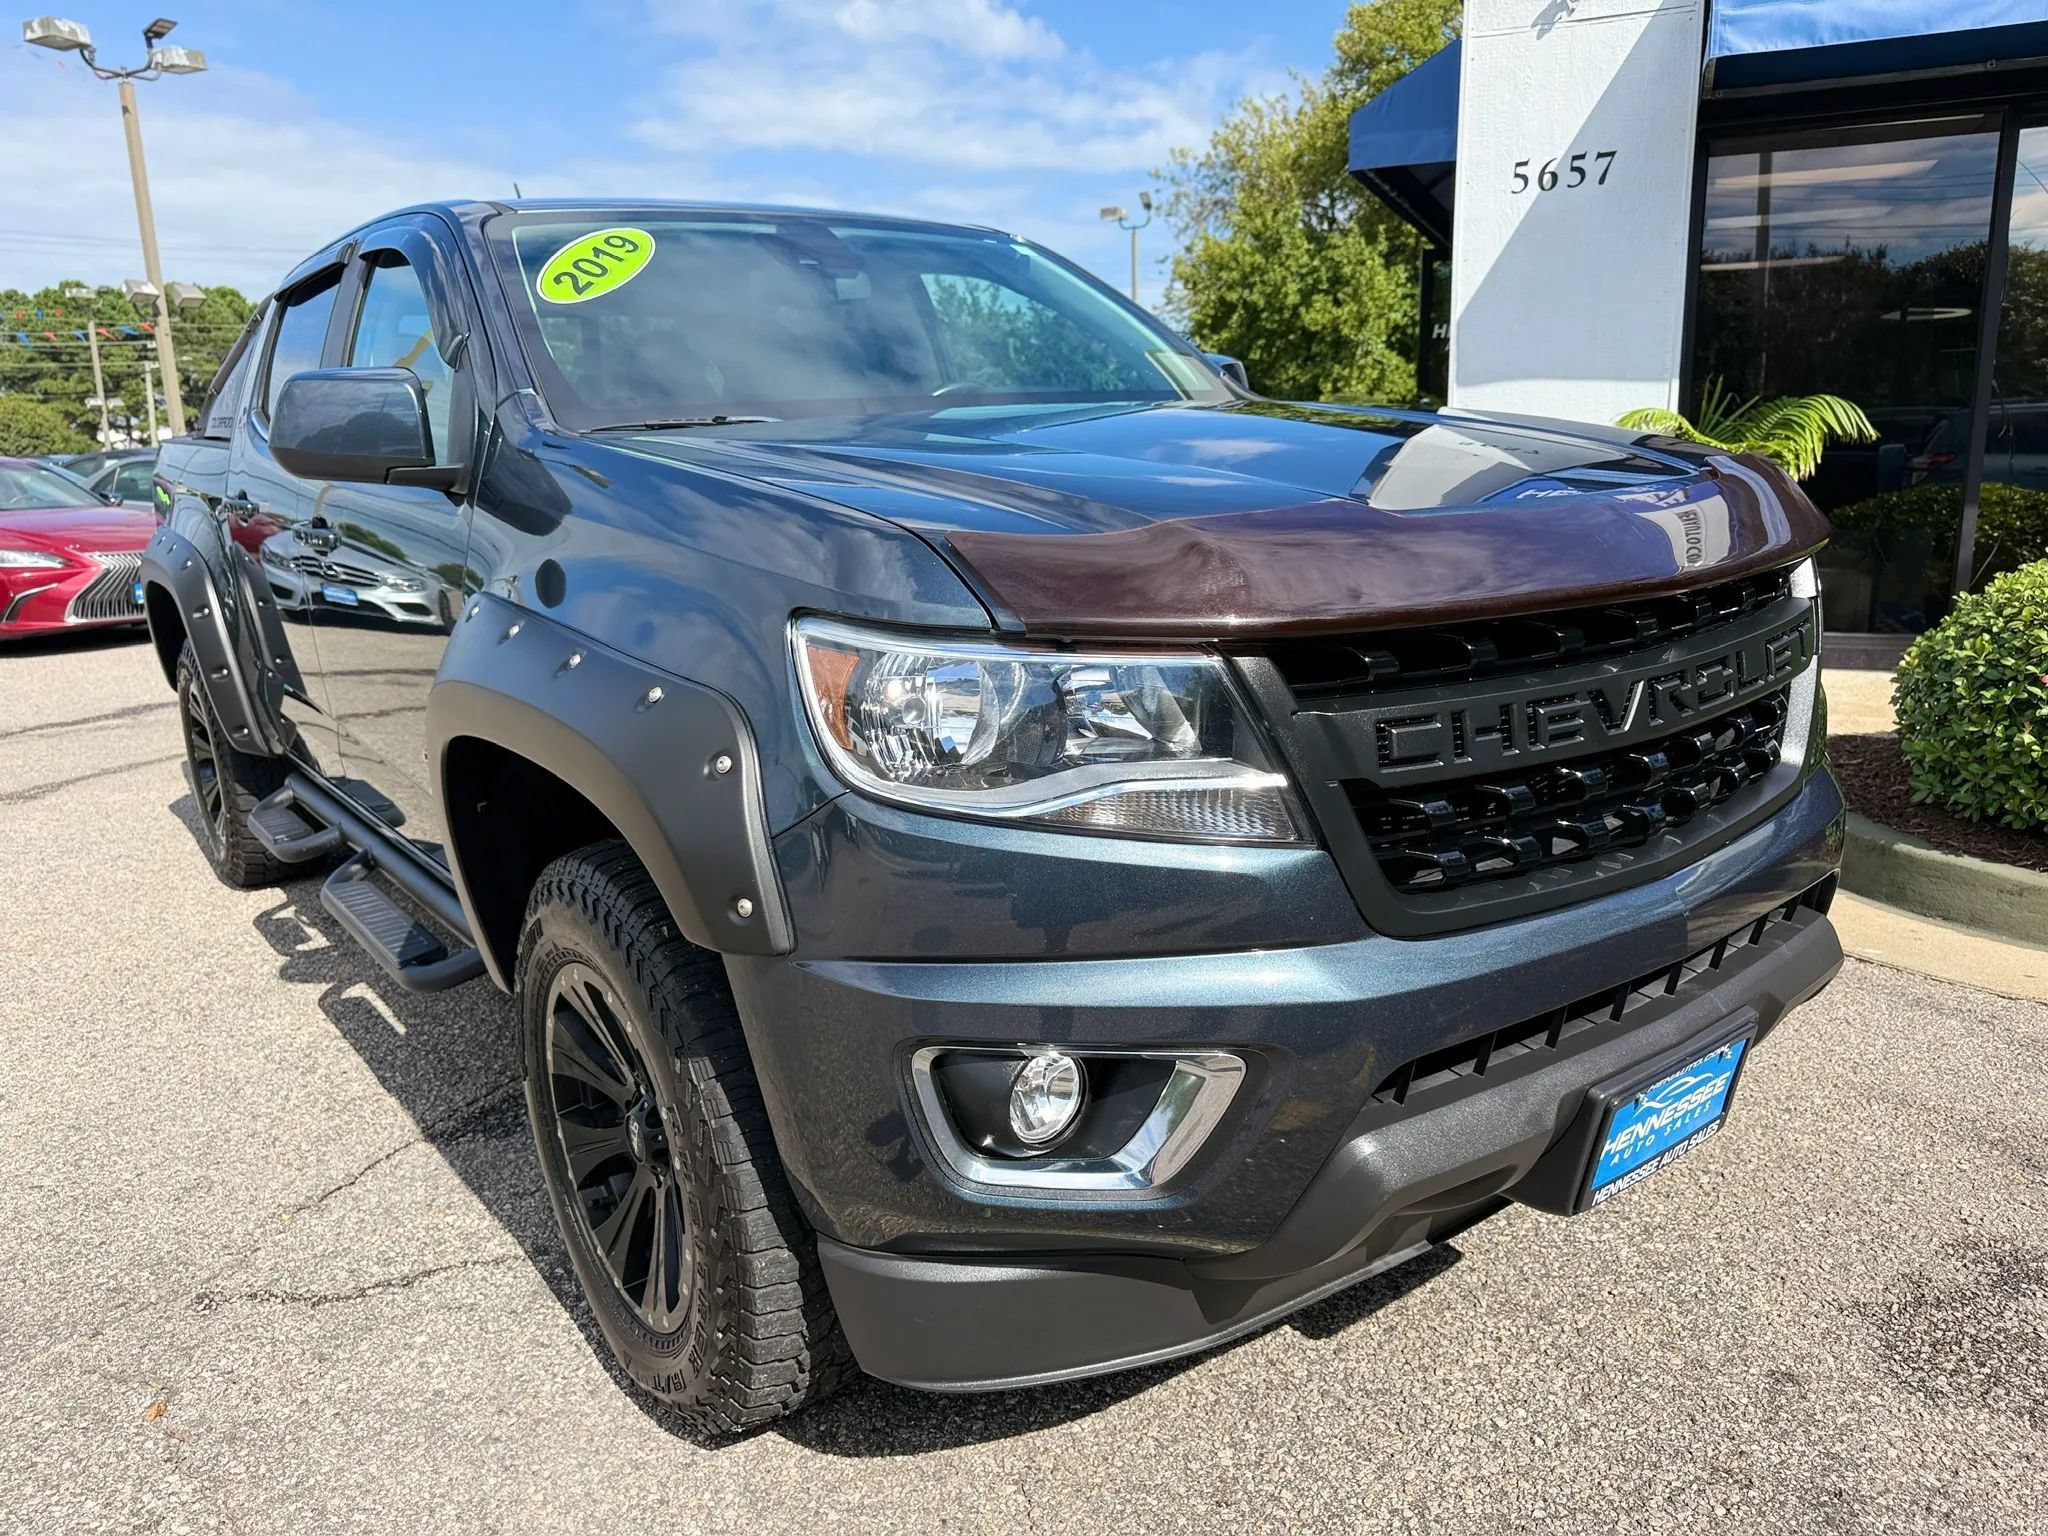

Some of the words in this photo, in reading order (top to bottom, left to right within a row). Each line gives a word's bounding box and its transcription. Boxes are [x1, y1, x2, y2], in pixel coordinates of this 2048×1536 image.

[1510, 150, 1618, 194] 5657
[553, 235, 640, 296] 2019
[1375, 621, 1812, 774] CHEVROLET
[1600, 1071, 1732, 1161] HENNESSEE
[1609, 1135, 1655, 1167] AUTO
[1663, 1100, 1712, 1137] SALES
[1591, 1157, 1661, 1206] HENNESSEE
[1657, 1139, 1690, 1170] AUTO
[1686, 1119, 1721, 1150] SALES
